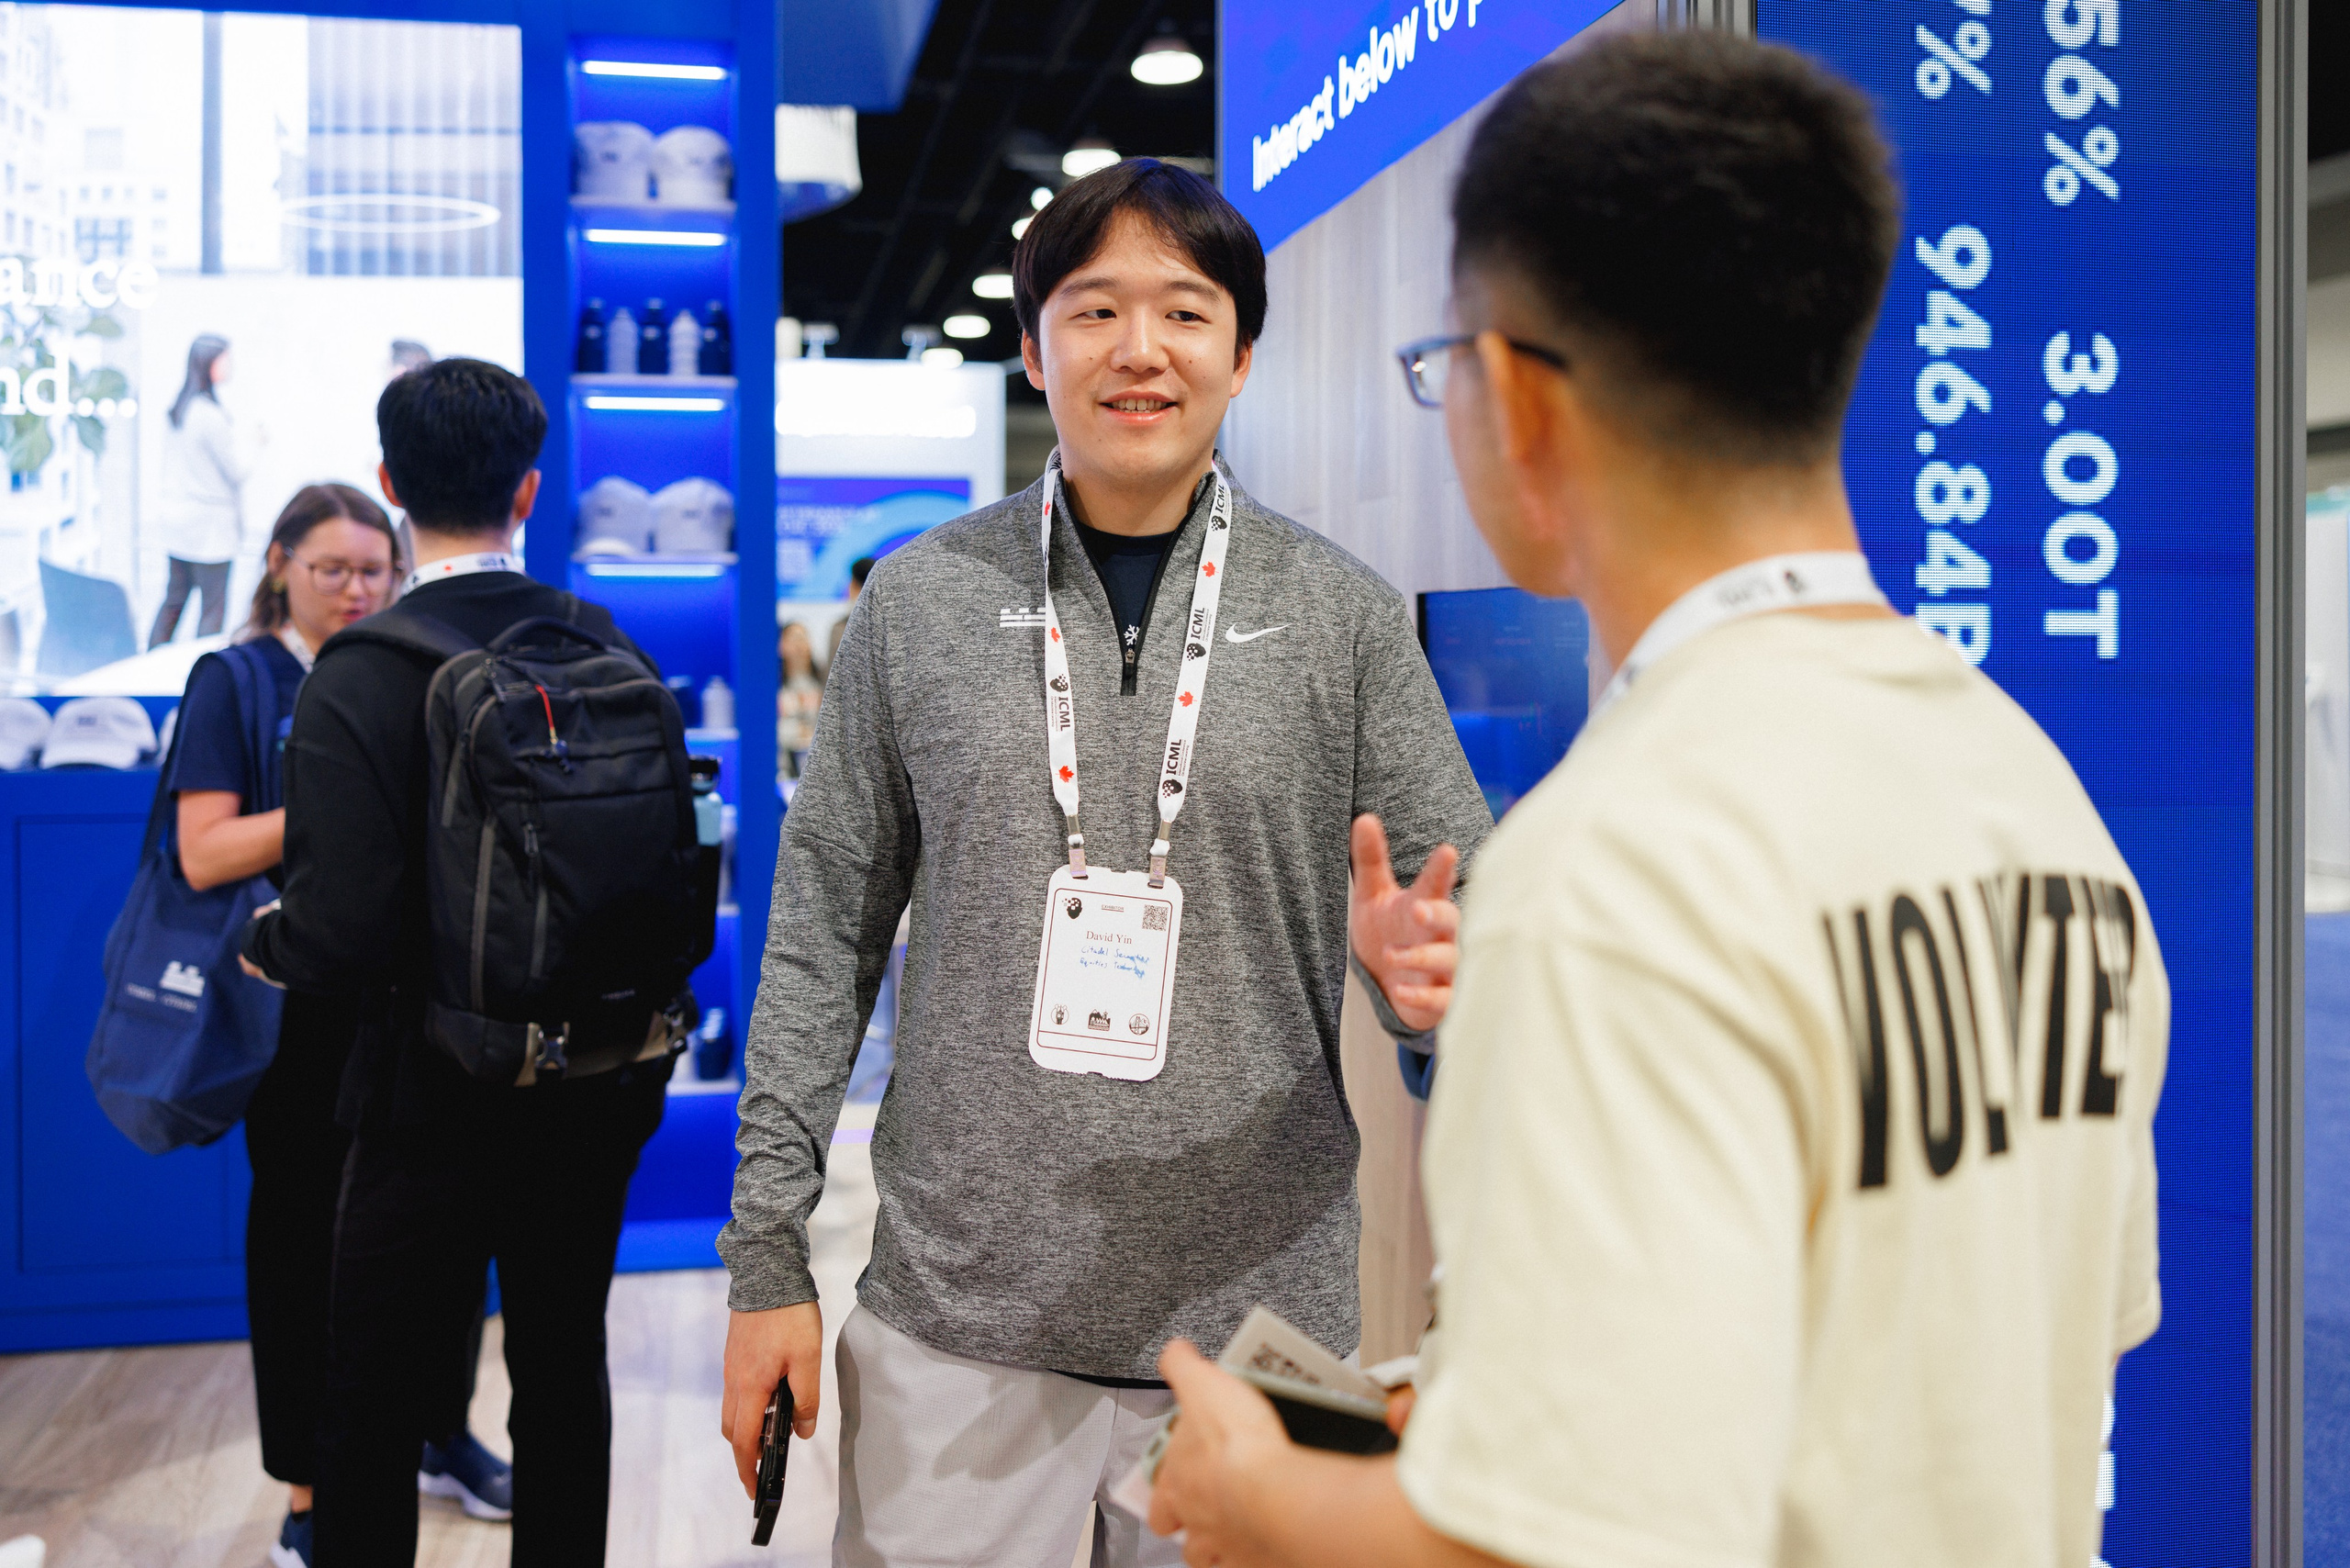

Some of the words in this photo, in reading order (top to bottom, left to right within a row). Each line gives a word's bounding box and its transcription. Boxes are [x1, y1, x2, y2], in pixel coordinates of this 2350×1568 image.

[1252, 74, 1335, 192] Interact
[1338, 6, 1419, 119] below
[0, 256, 160, 309] ance
[1214, 484, 1225, 513] ICML
[2043, 330, 2120, 659] 3.00T
[1191, 607, 1205, 640] ICML
[1058, 697, 1070, 732] ICML
[1166, 739, 1181, 775] ICML
[1086, 930, 1113, 942] David
[1116, 934, 1132, 945] Yin
